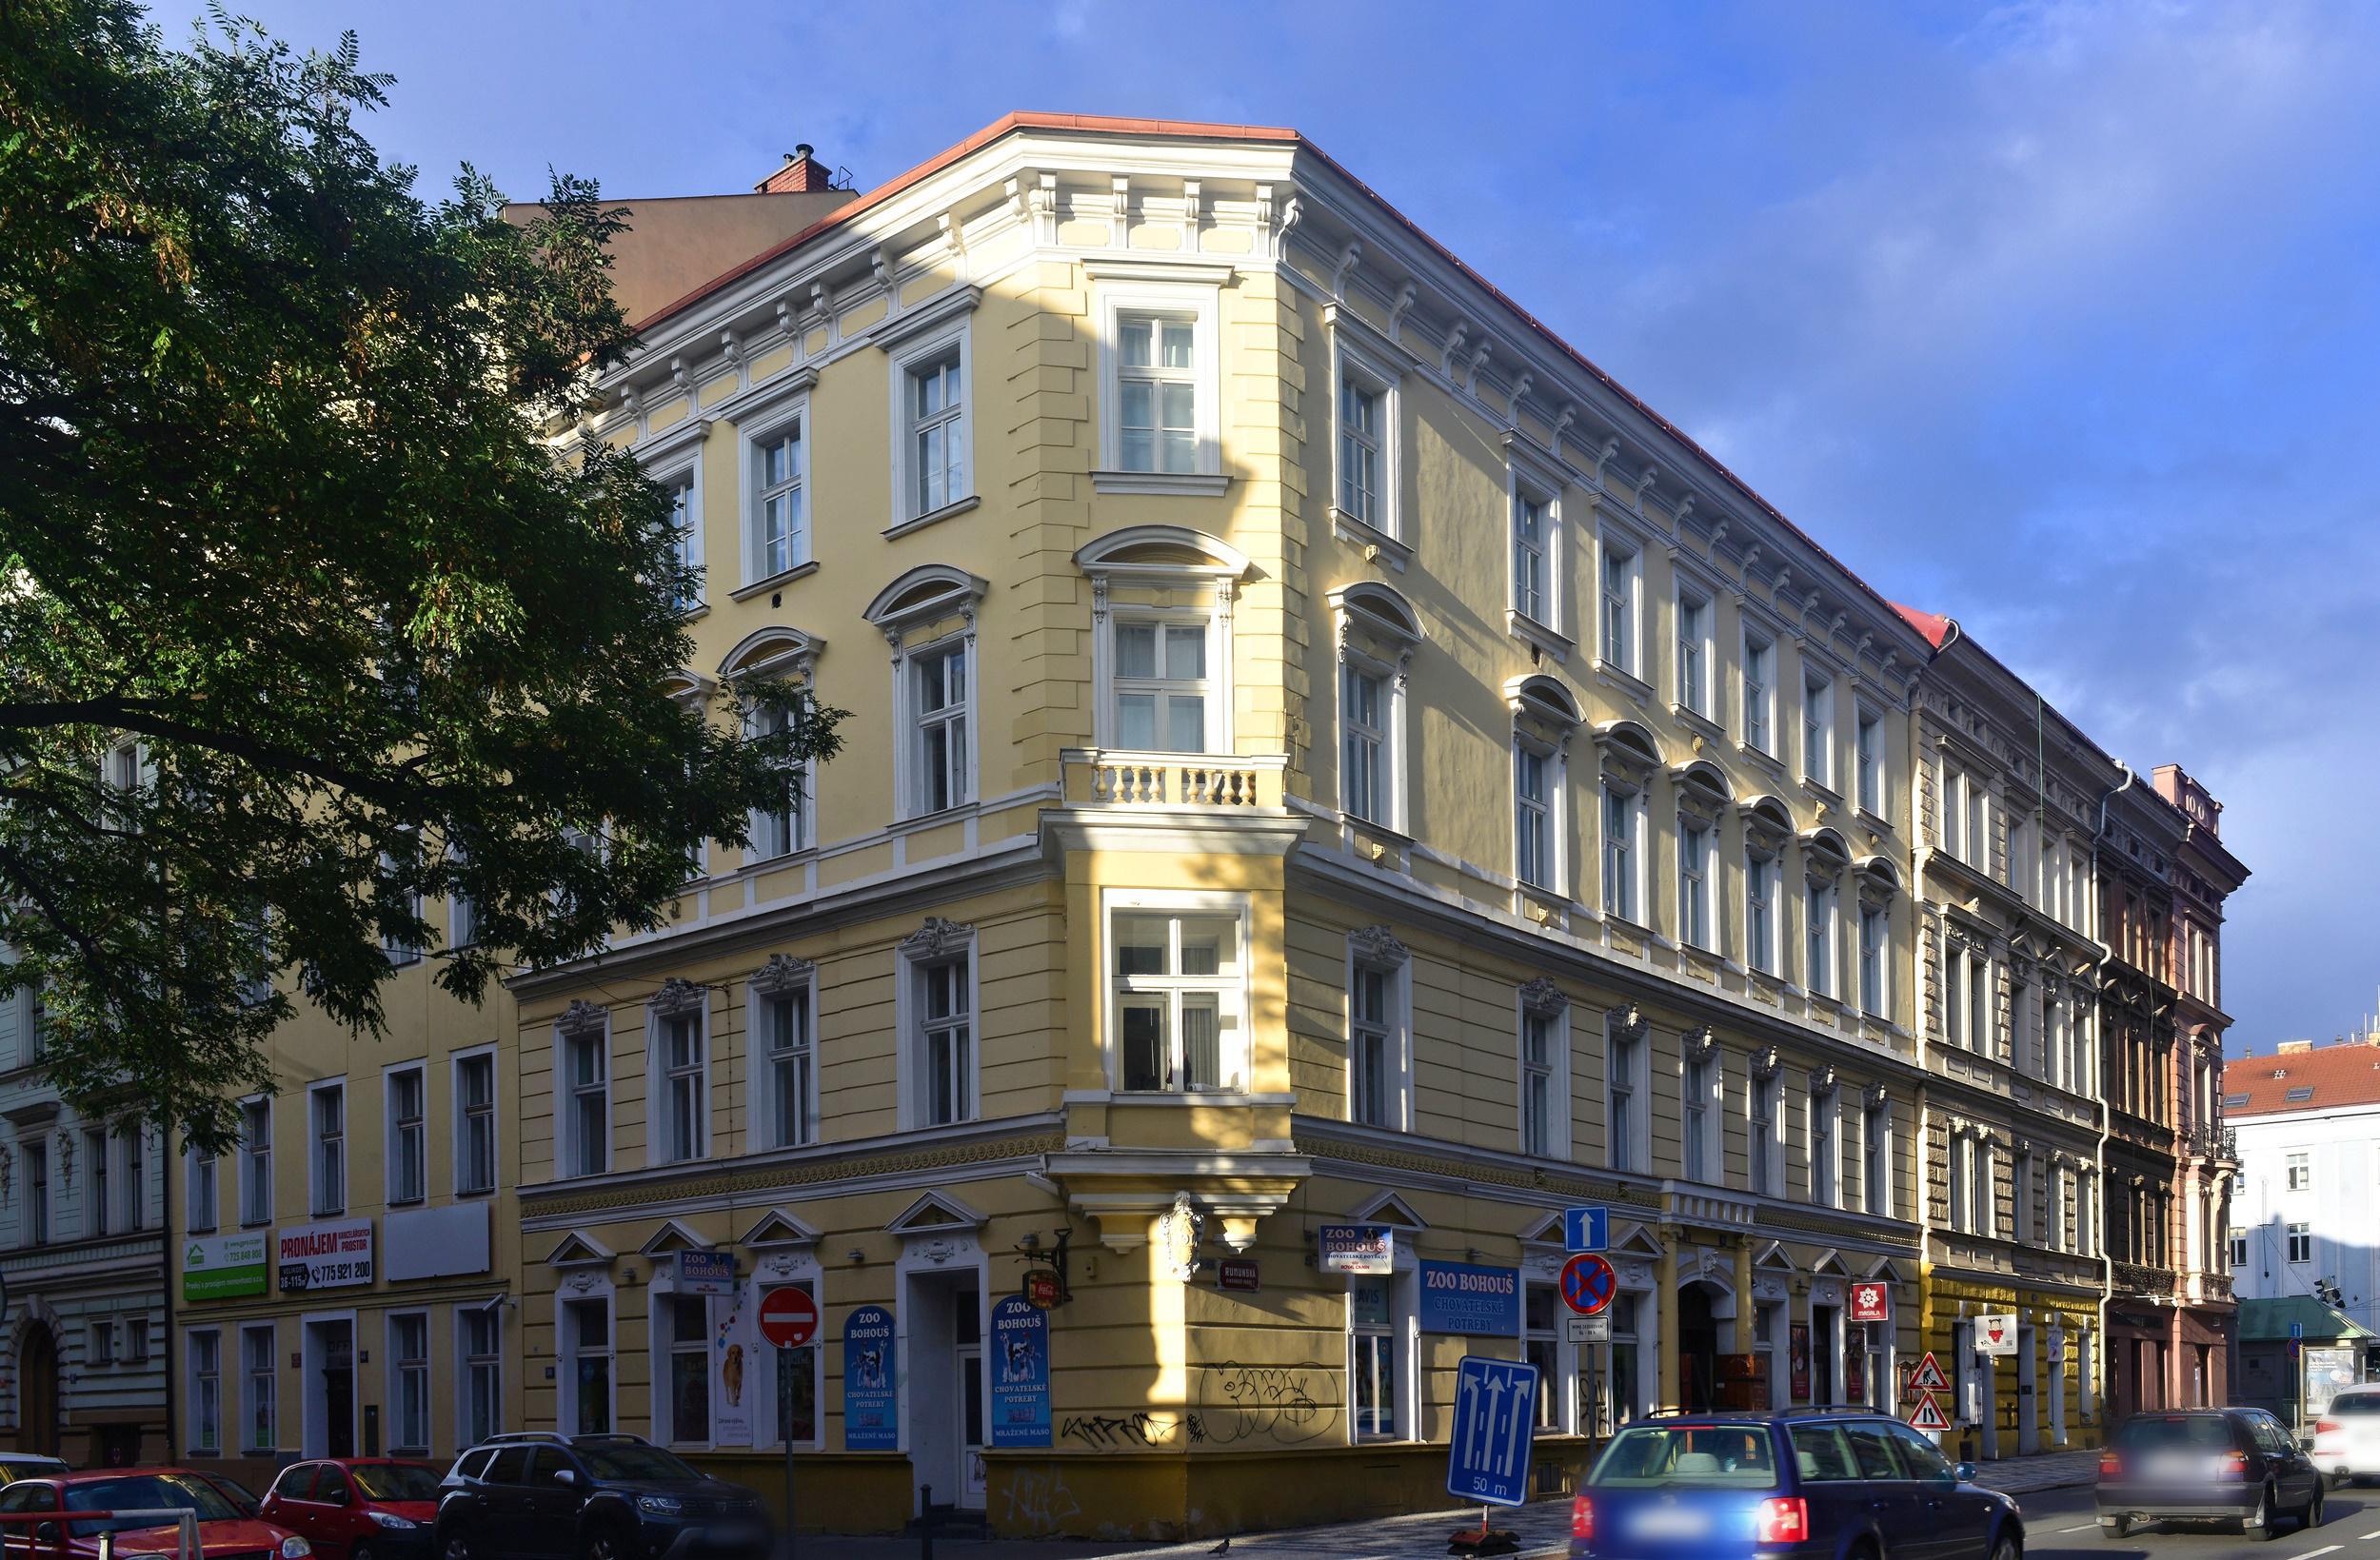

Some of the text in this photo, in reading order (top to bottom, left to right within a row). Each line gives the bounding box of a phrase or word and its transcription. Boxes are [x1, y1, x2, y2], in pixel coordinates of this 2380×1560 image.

[1325, 1228, 1356, 1239] ZOO
[281, 1231, 338, 1259] PRONÁJEM
[341, 1239, 367, 1252] PROSTOR
[1325, 1238, 1386, 1253] BOHOUŠ
[684, 1254, 706, 1264] ZOO
[322, 1261, 370, 1281] 775 921 200
[685, 1263, 729, 1276] BOHOUŠ
[1426, 1270, 1515, 1294] ZOO BOHOUŠ
[1006, 1301, 1031, 1314] ZOO
[1433, 1296, 1504, 1313] CHOVATELSKÉ
[859, 1313, 881, 1324] ZOO
[997, 1314, 1041, 1330] BOHOUŠ
[1448, 1313, 1493, 1332] POTŘEBY
[850, 1325, 890, 1339] BOHOUŠ
[847, 1390, 893, 1399] CHOVATELSKÉ
[994, 1382, 1047, 1394] CHOVATELSKÉ
[855, 1398, 886, 1409] POTŘEBY
[1004, 1392, 1038, 1403] POTŘEBY
[847, 1430, 896, 1440] MRAŽENÉ MASO
[995, 1427, 1051, 1437] MRAŽENÉ MASO
[1473, 1476, 1508, 1496] 50 m
